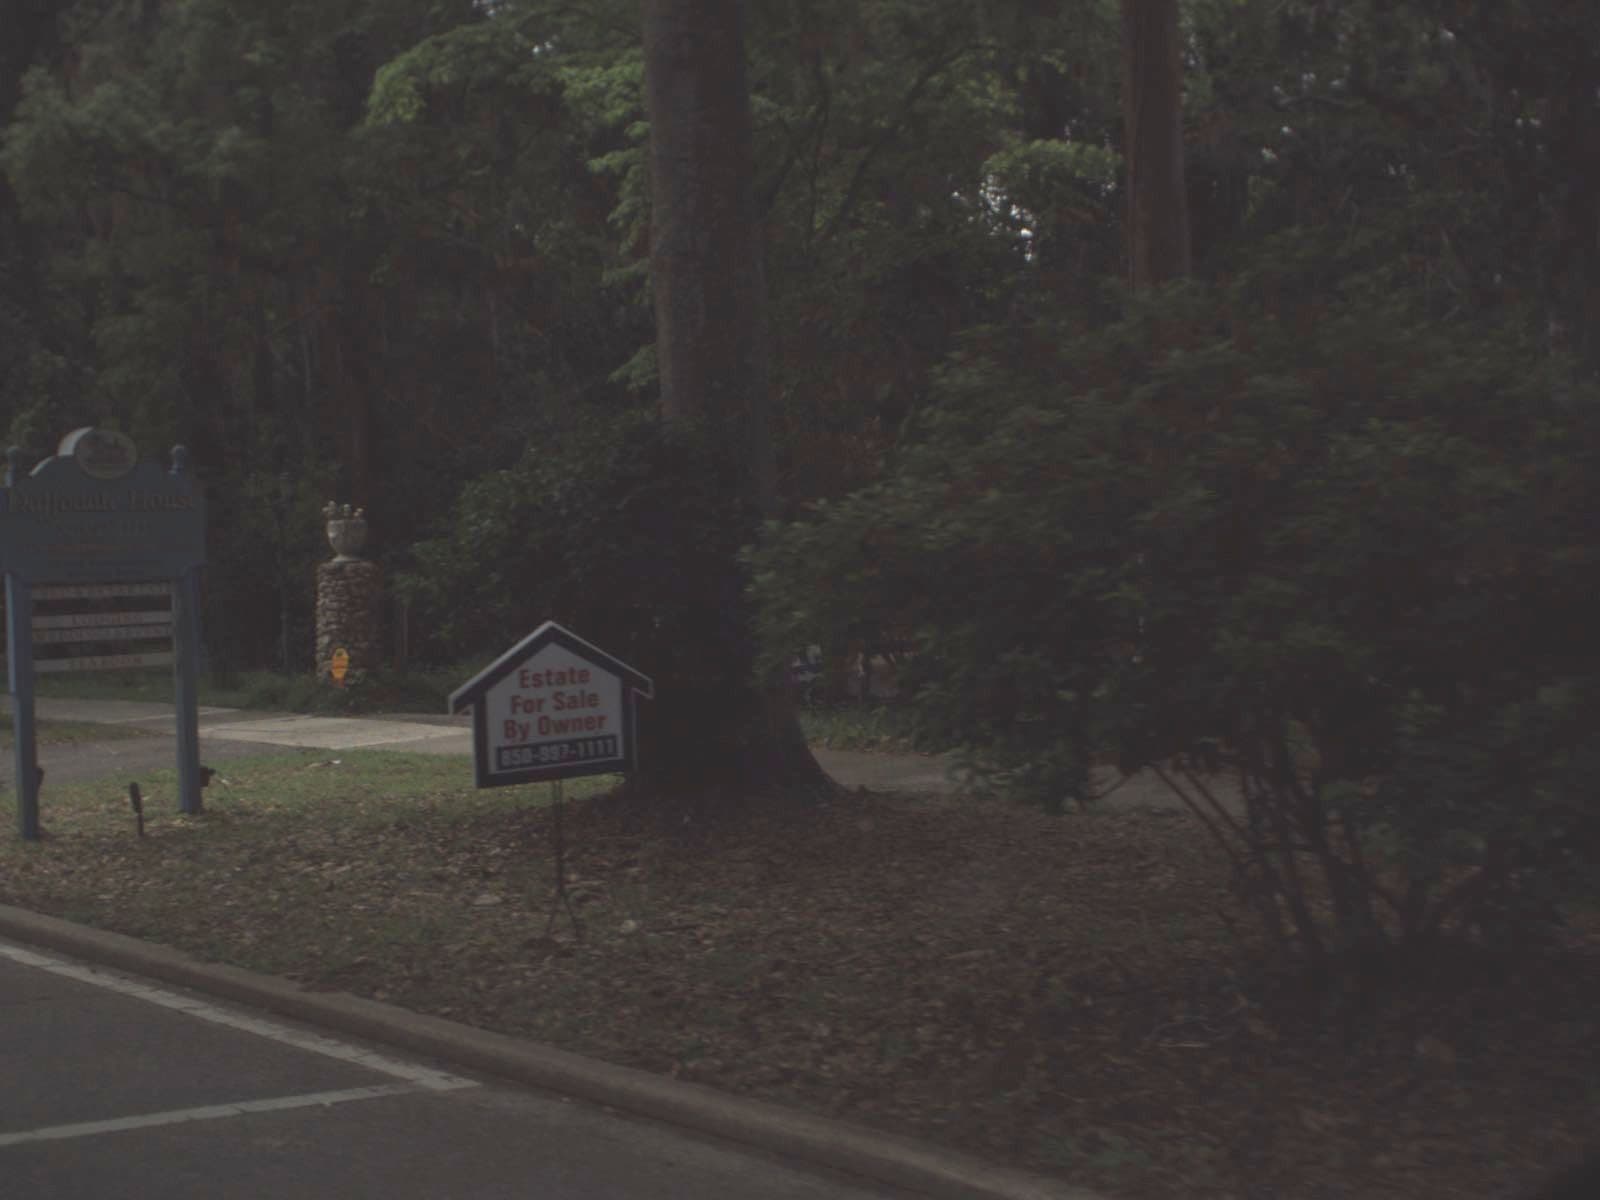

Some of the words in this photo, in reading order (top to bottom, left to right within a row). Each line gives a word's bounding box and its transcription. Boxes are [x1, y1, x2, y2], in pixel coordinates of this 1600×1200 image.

[518, 667, 591, 688] Estate
[510, 694, 546, 714] For
[552, 689, 600, 711] Sale
[503, 719, 530, 742] By
[538, 714, 607, 735] Owner
